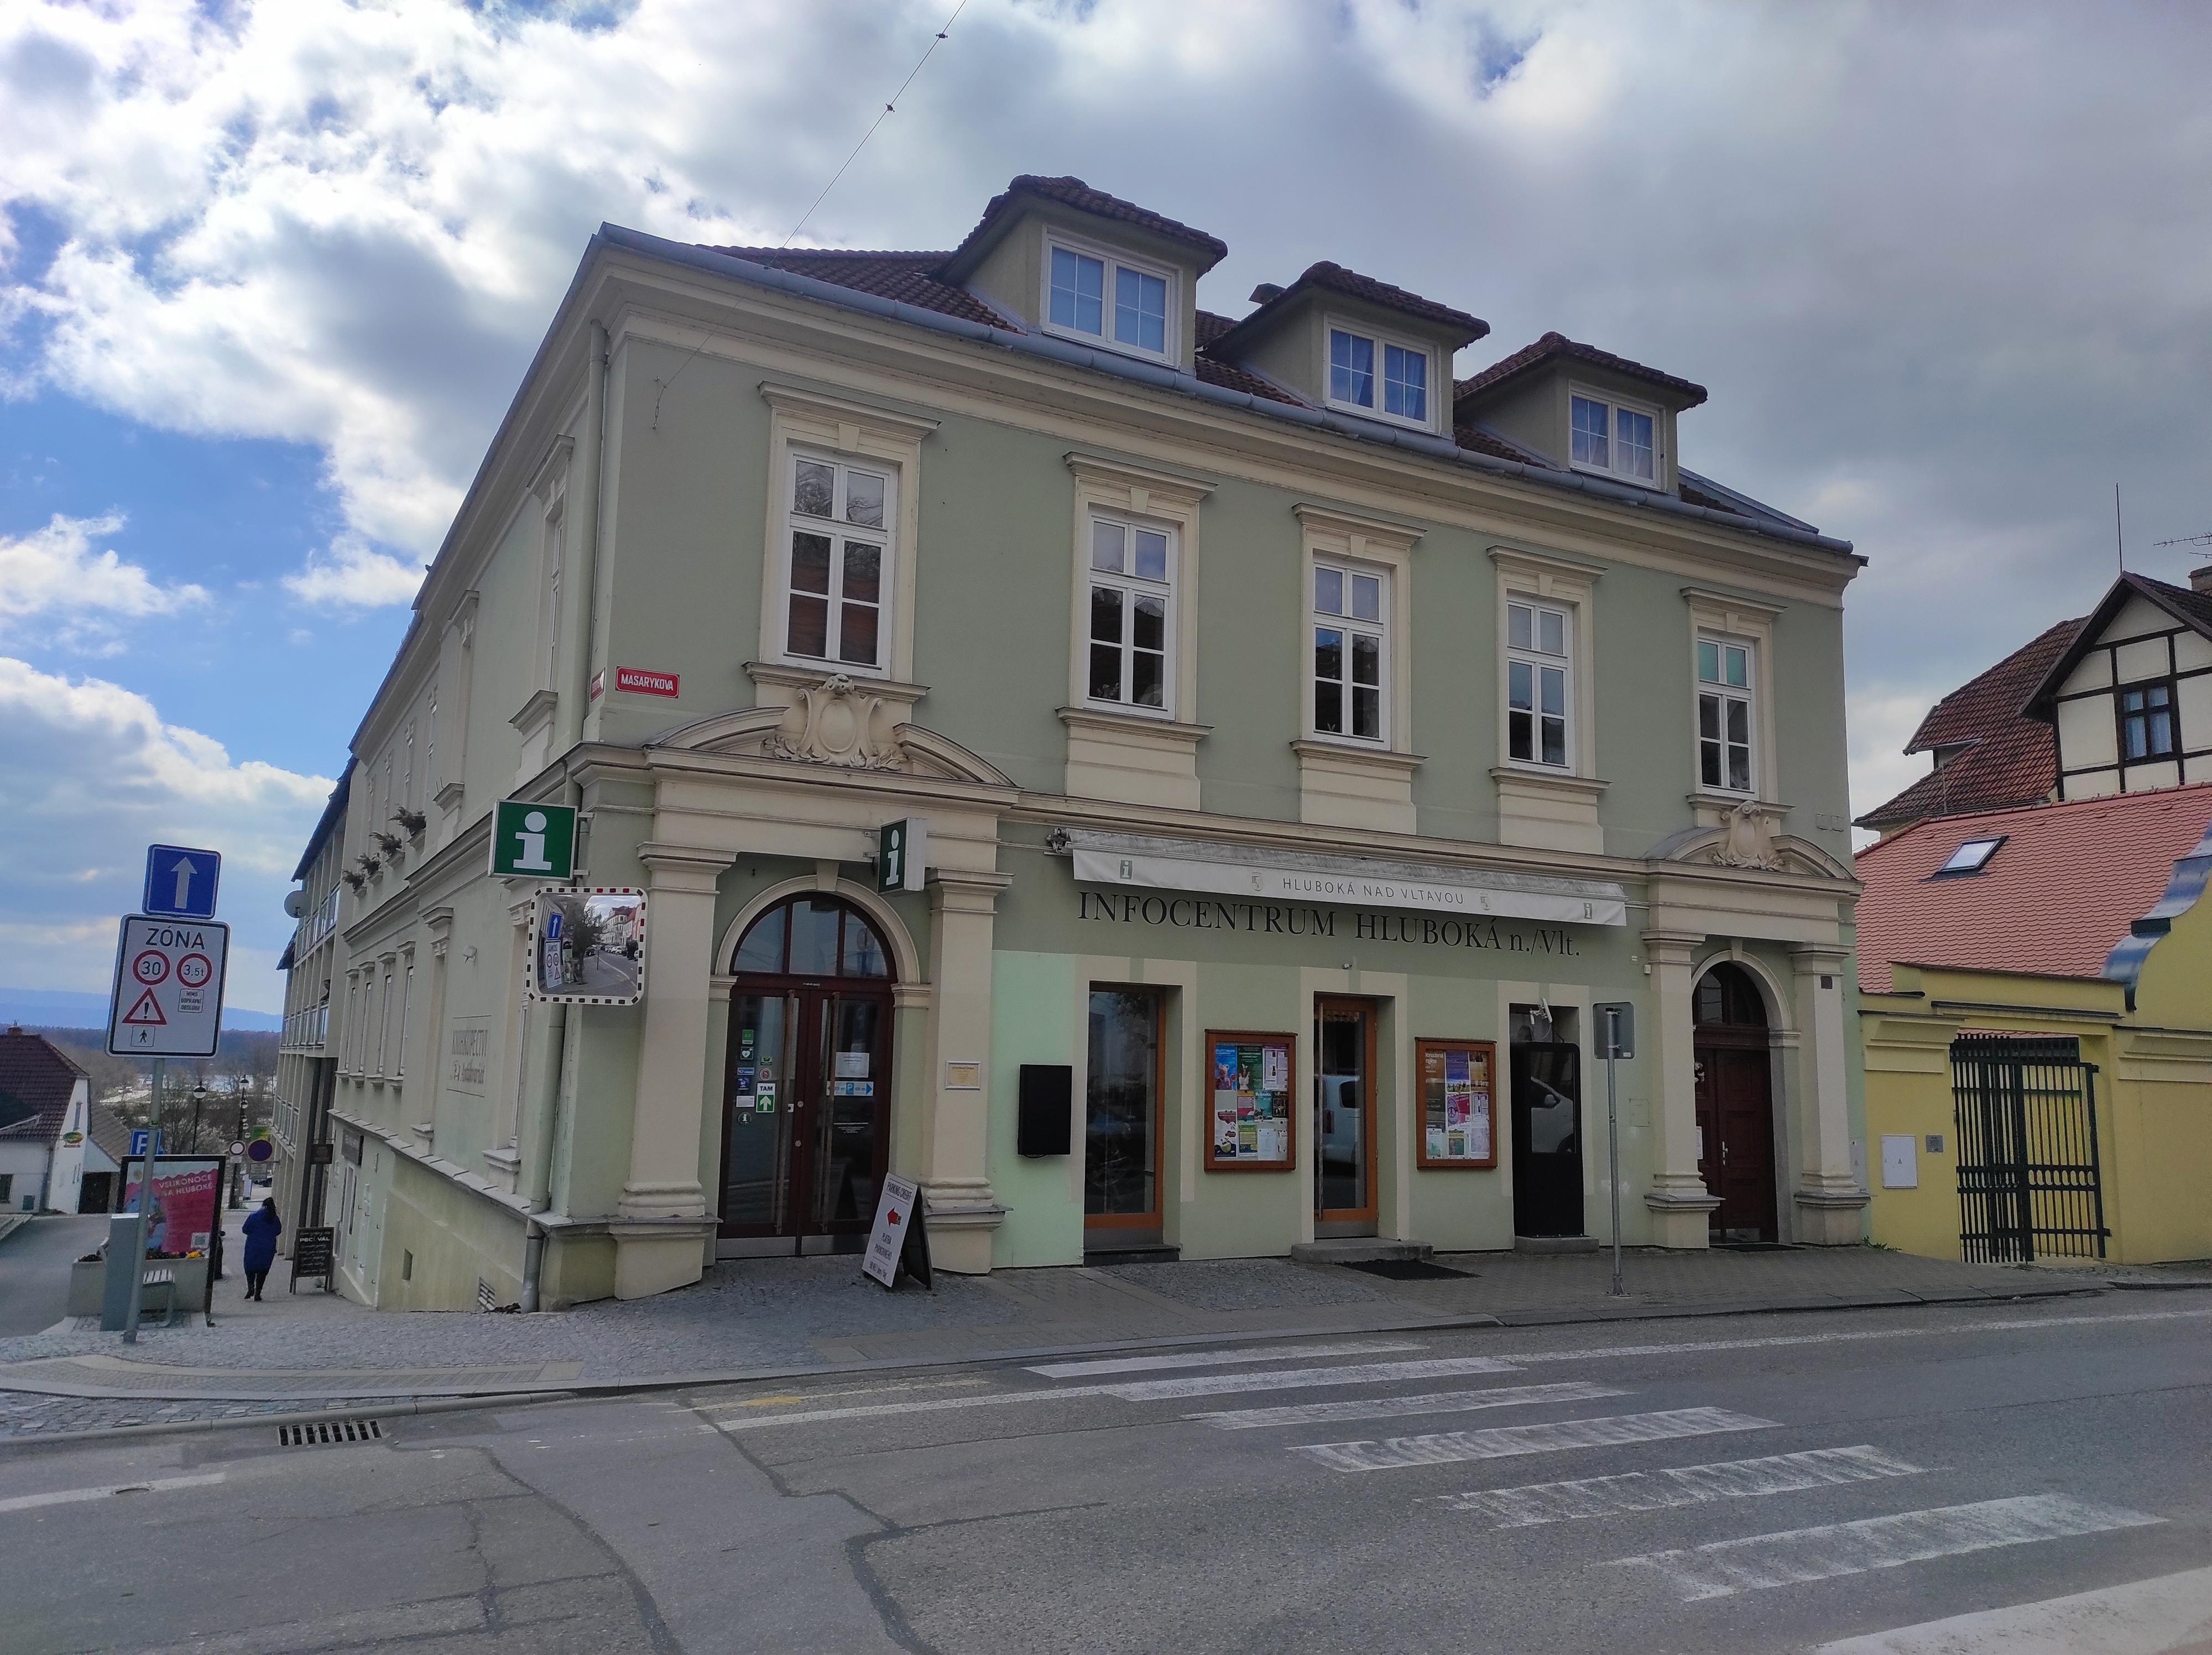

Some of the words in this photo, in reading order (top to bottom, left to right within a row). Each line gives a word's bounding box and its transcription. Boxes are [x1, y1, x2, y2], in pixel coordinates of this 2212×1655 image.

[620, 674, 674, 691] MASARYKOVA
[1283, 878, 1355, 895] HLUBOKÁ
[1364, 886, 1394, 898] NAD
[1401, 888, 1464, 904] VLTAVOU
[1077, 891, 1335, 937] INFOCENTRUM
[1355, 913, 1503, 951] HLUBOKÁ
[145, 925, 205, 950] ZÓNA
[141, 960, 161, 975] 30
[159, 1174, 212, 1188] VELIKONOCE
[887, 1181, 901, 1197] PARKING
